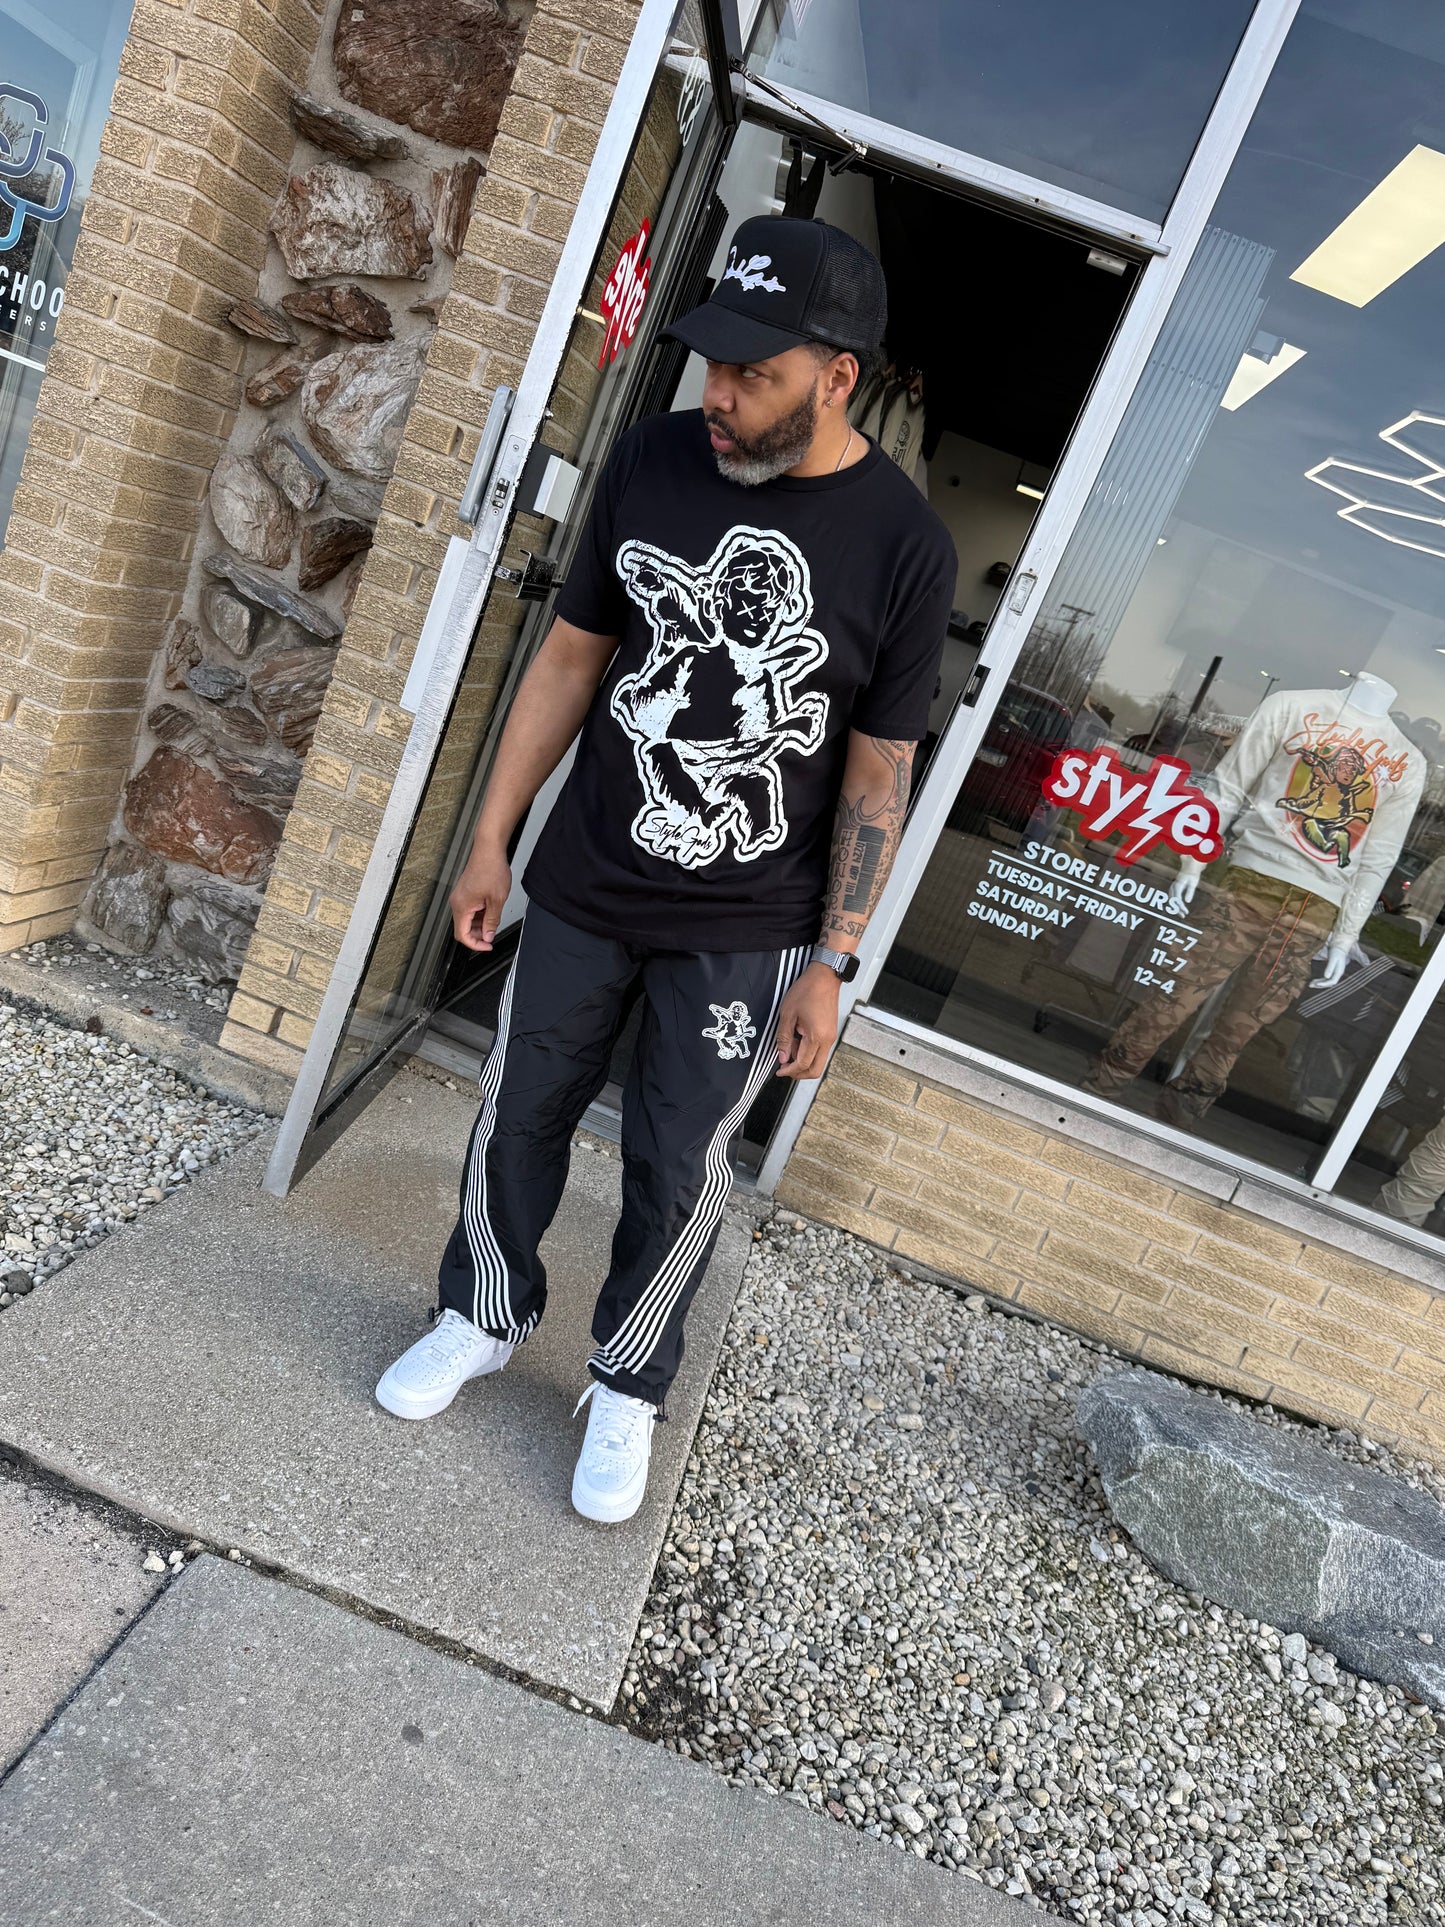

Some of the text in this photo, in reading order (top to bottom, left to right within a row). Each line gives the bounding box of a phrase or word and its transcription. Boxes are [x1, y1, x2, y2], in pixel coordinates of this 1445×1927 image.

[986, 858, 1199, 952] TUESDAY-FRIDAY 12-7
[1024, 841, 1180, 917] STORE HOURS
[967, 901, 1176, 994] SUNDAY 12-4
[976, 880, 1188, 973] SATURDAY 11-7
